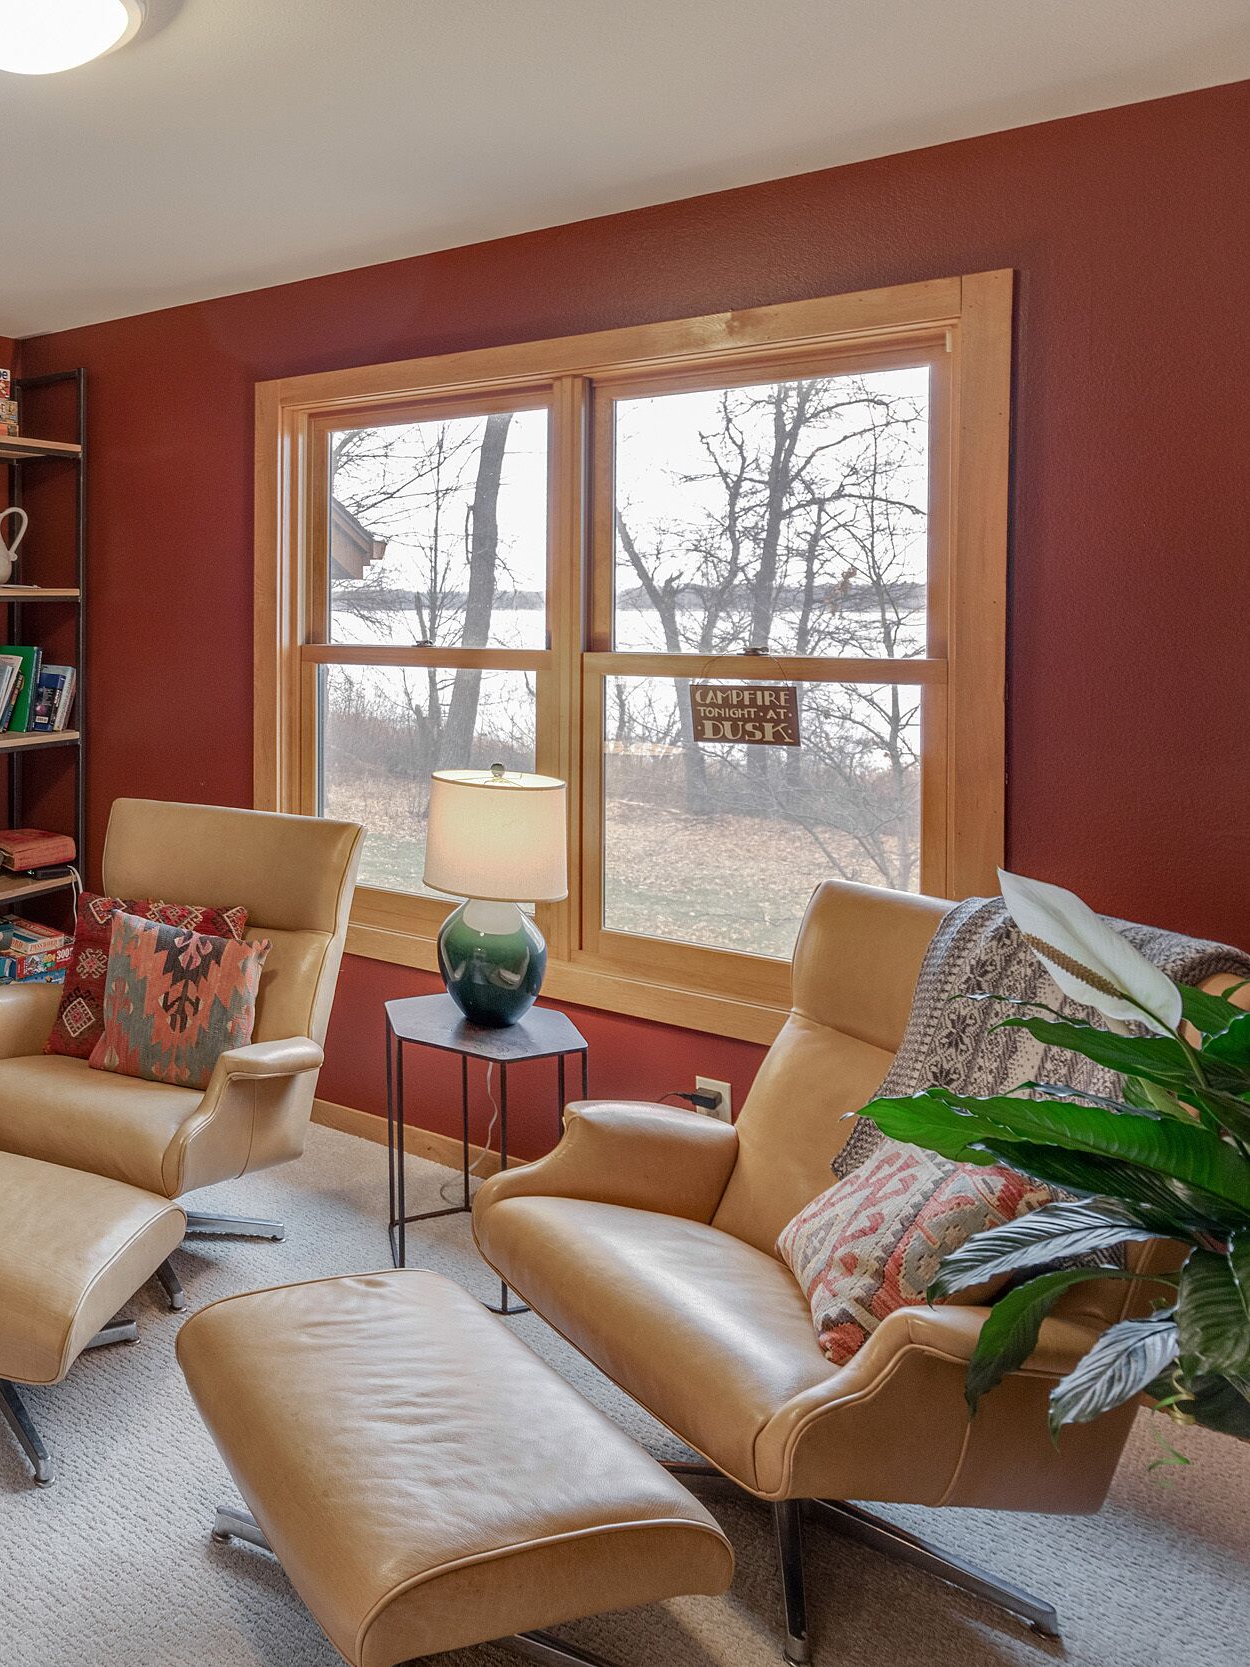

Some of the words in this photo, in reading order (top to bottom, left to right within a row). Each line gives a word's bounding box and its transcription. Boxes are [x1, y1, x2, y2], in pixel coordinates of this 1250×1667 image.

[695, 689, 790, 706] CAMPFIRE
[697, 706, 757, 719] TONIGHT
[766, 709, 787, 719] AT
[702, 720, 794, 743] DUSK
